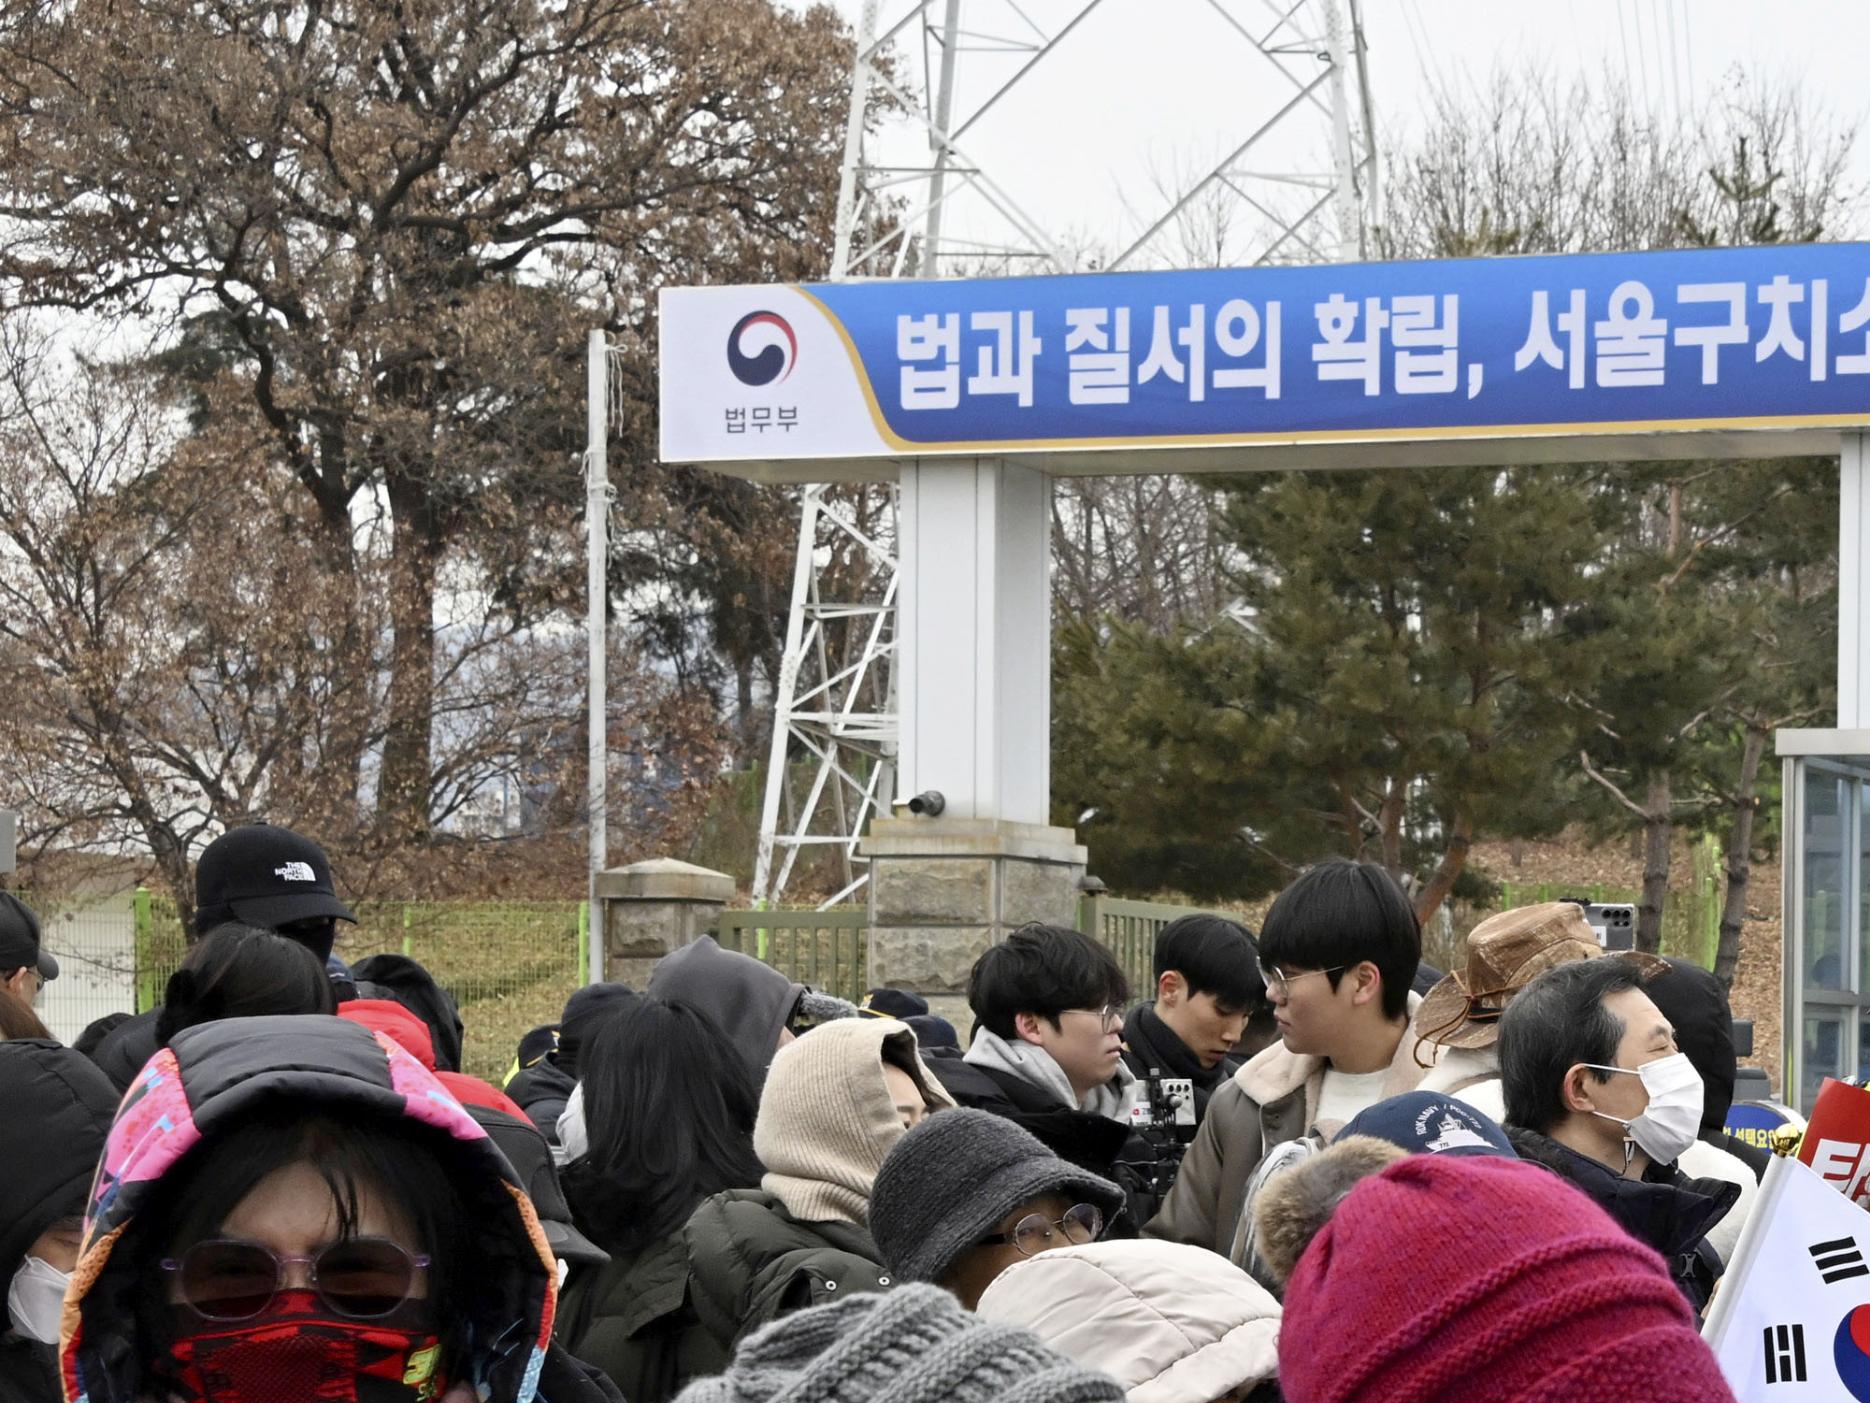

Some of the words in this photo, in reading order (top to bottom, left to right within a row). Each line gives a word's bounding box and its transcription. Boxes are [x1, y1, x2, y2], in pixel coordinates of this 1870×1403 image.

[897, 310, 1042, 409] 법과
[1065, 299, 1281, 405] 질서의
[1311, 293, 1484, 399] 확립,
[725, 405, 798, 433] 법무부
